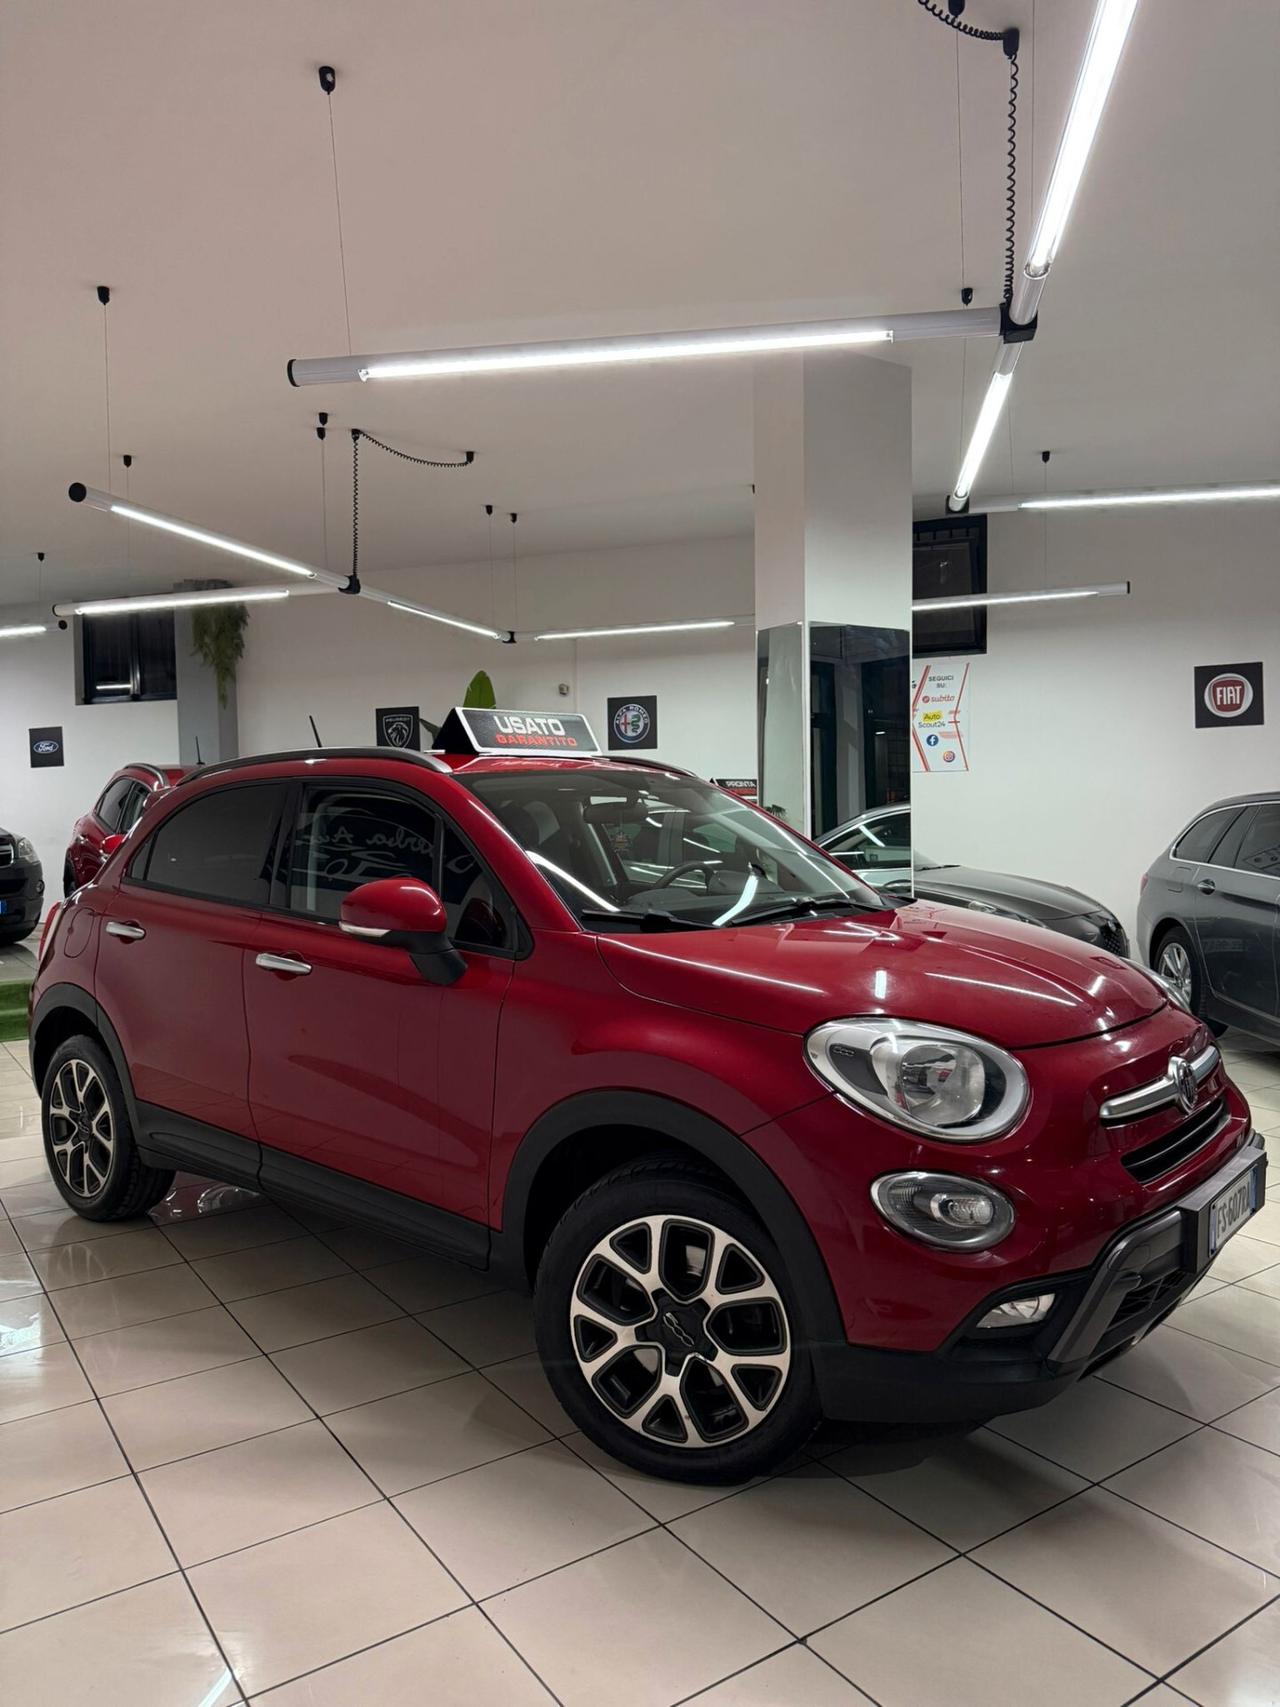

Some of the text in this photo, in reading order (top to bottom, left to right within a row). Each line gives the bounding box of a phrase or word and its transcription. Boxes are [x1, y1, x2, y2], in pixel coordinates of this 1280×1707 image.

[931, 695, 955, 703] subito
[1216, 686, 1242, 705] FIAT
[493, 715, 565, 736] USATO
[918, 721, 946, 729] Scout24
[496, 733, 577, 747] GARANTITO
